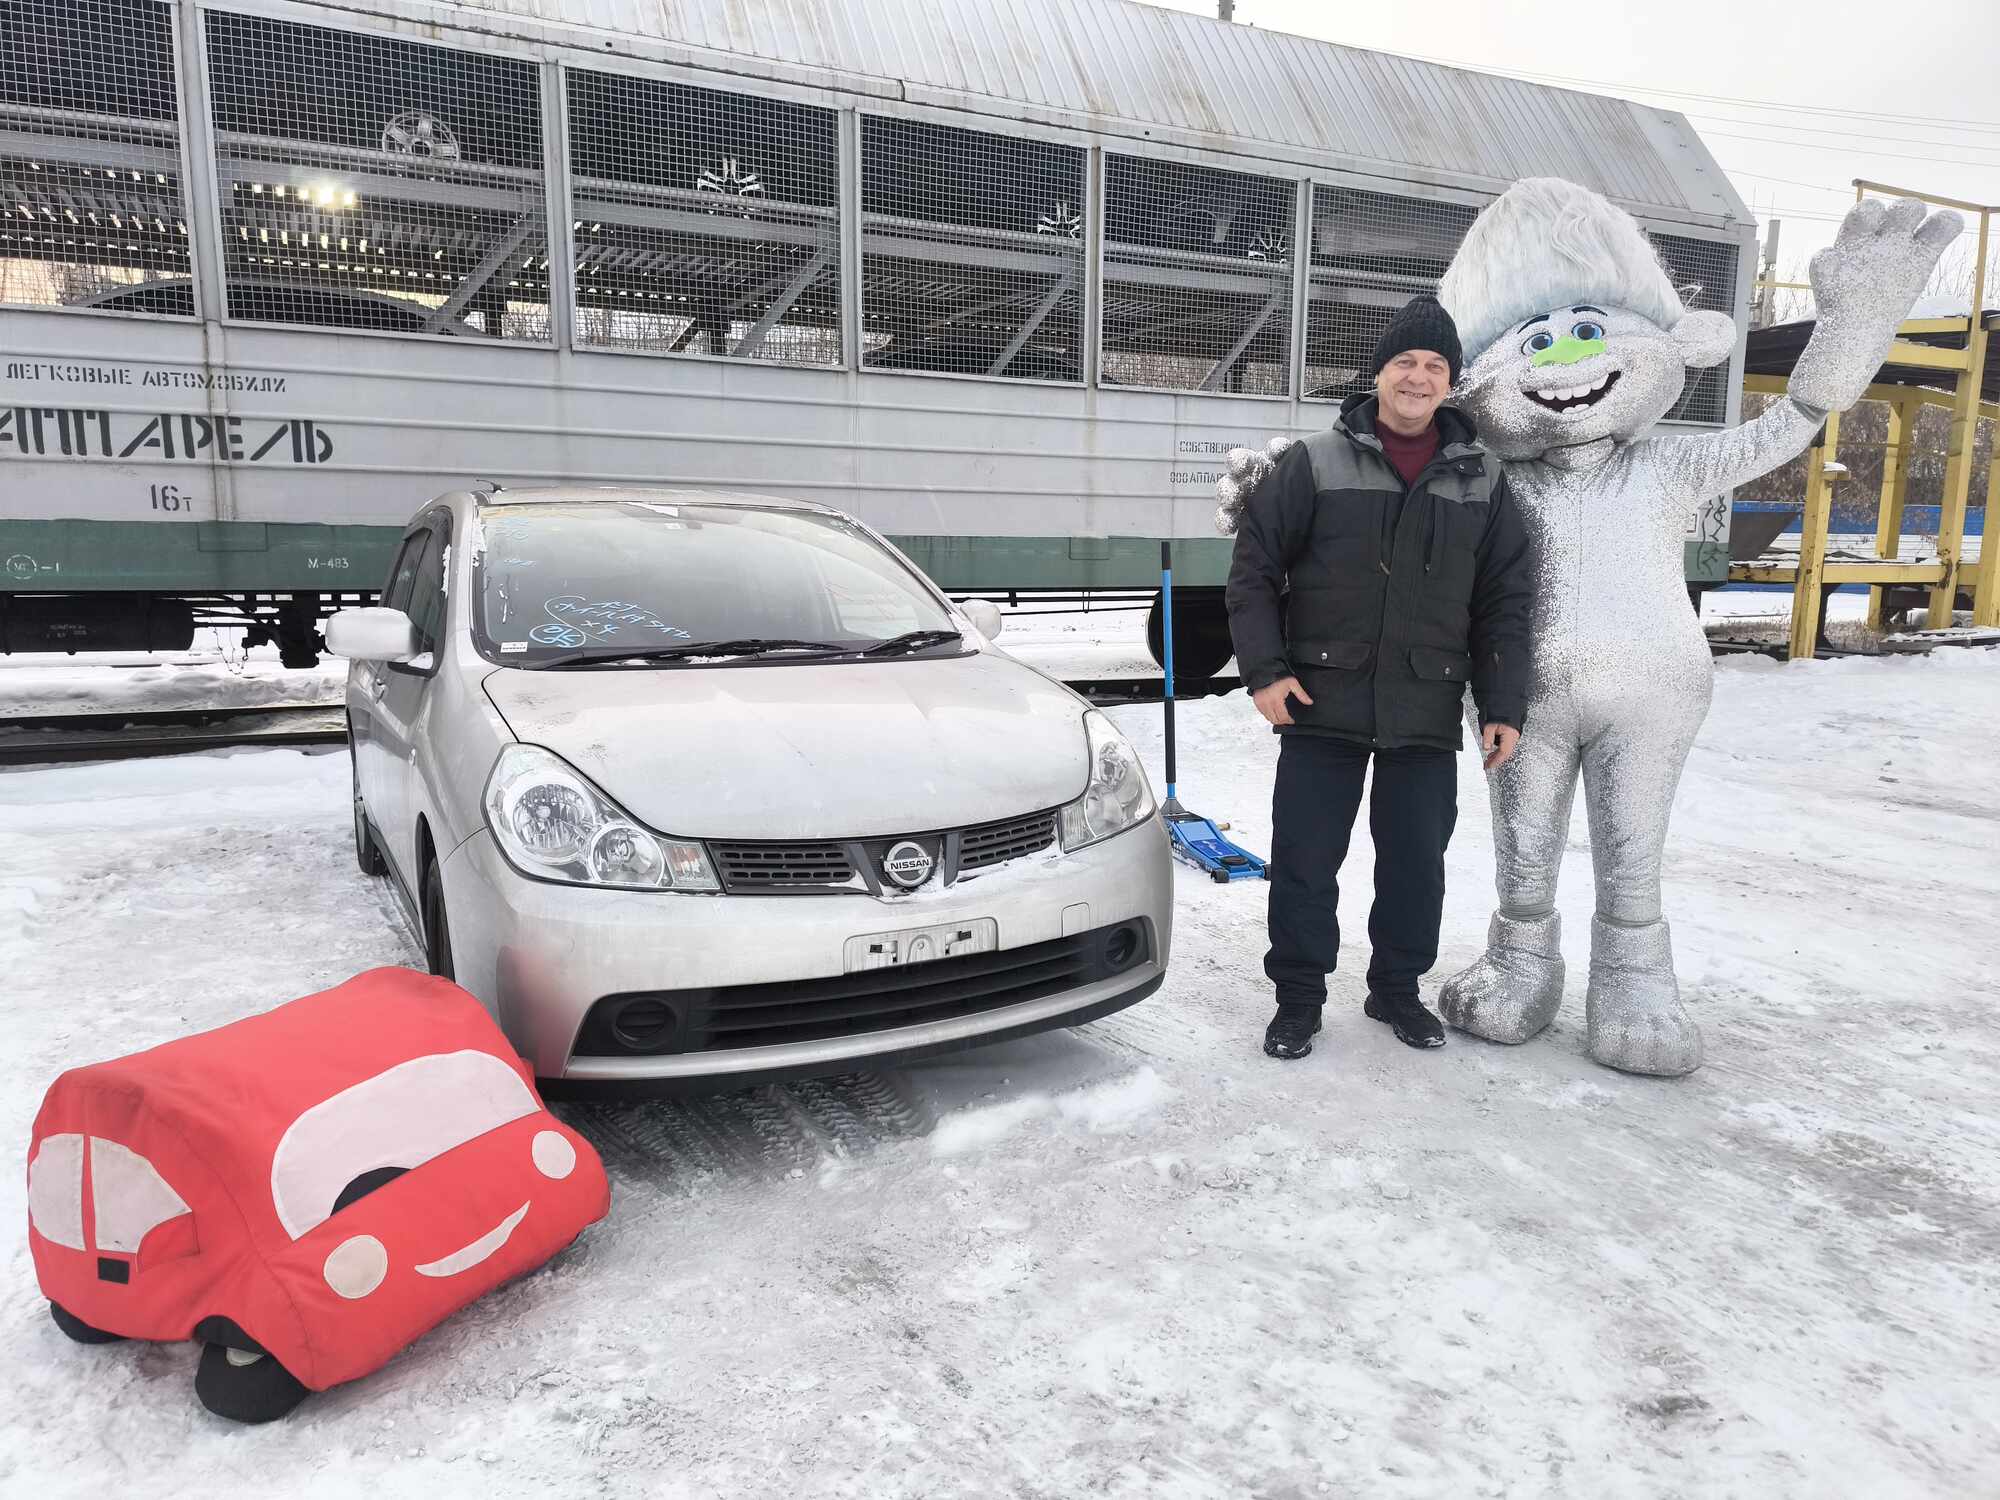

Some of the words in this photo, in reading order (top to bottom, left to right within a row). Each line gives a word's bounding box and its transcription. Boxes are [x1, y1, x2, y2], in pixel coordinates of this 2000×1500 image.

[6, 362, 132, 385] ЛЕГКОВЫЕ
[142, 371, 286, 393] АВТОМОБИЛИ
[0, 406, 333, 463] АППАРЕЛЬ
[890, 859, 930, 870] NISSAN
